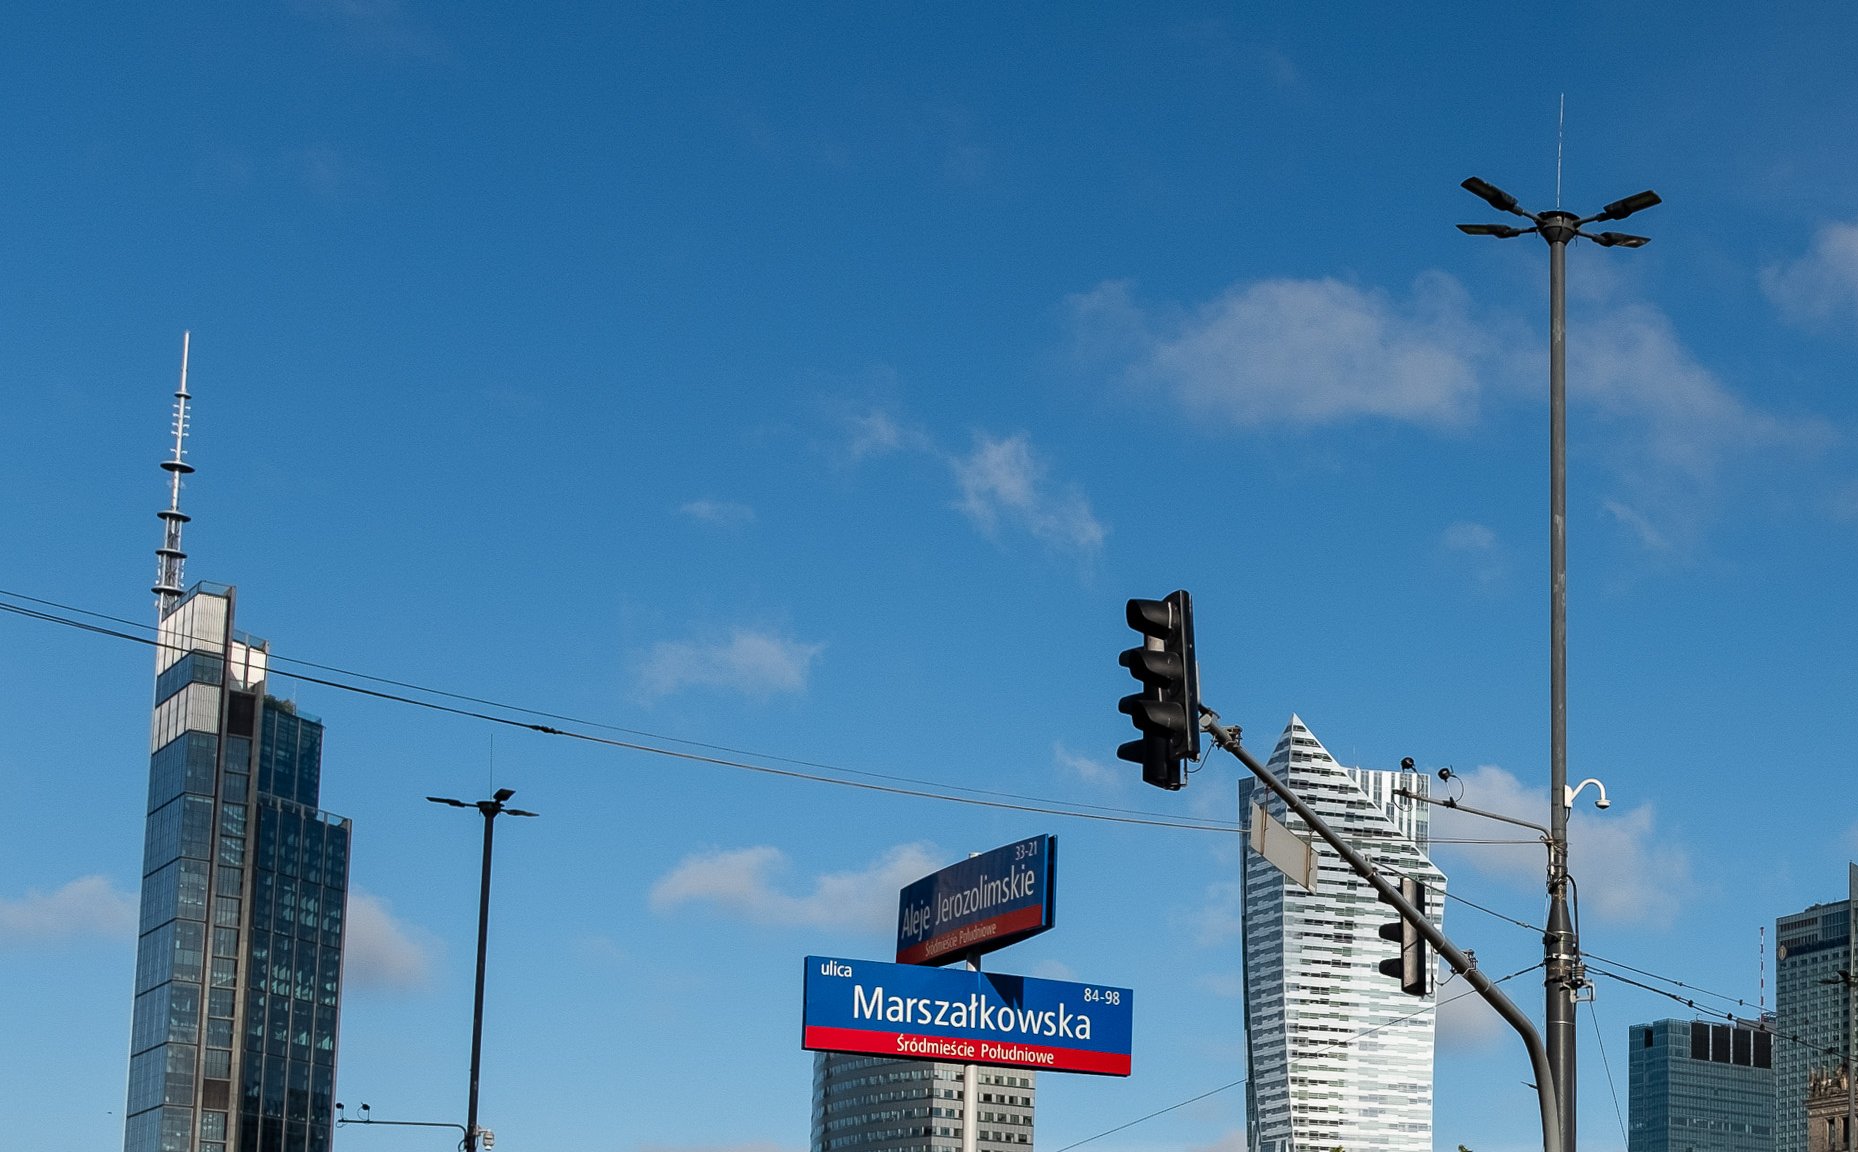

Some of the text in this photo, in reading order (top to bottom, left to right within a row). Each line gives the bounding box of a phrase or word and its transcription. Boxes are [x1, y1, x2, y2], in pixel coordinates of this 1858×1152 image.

[1015, 841, 1038, 861] 33-21
[902, 864, 1035, 941] Aleje Jerozolimskie
[925, 922, 997, 957] Śródmieście Południowe
[821, 961, 853, 979] ulica
[853, 985, 1091, 1040] Marszałkowska
[1084, 987, 1120, 1007] 84-98
[896, 1031, 1054, 1065] Śródmieście Południowe
